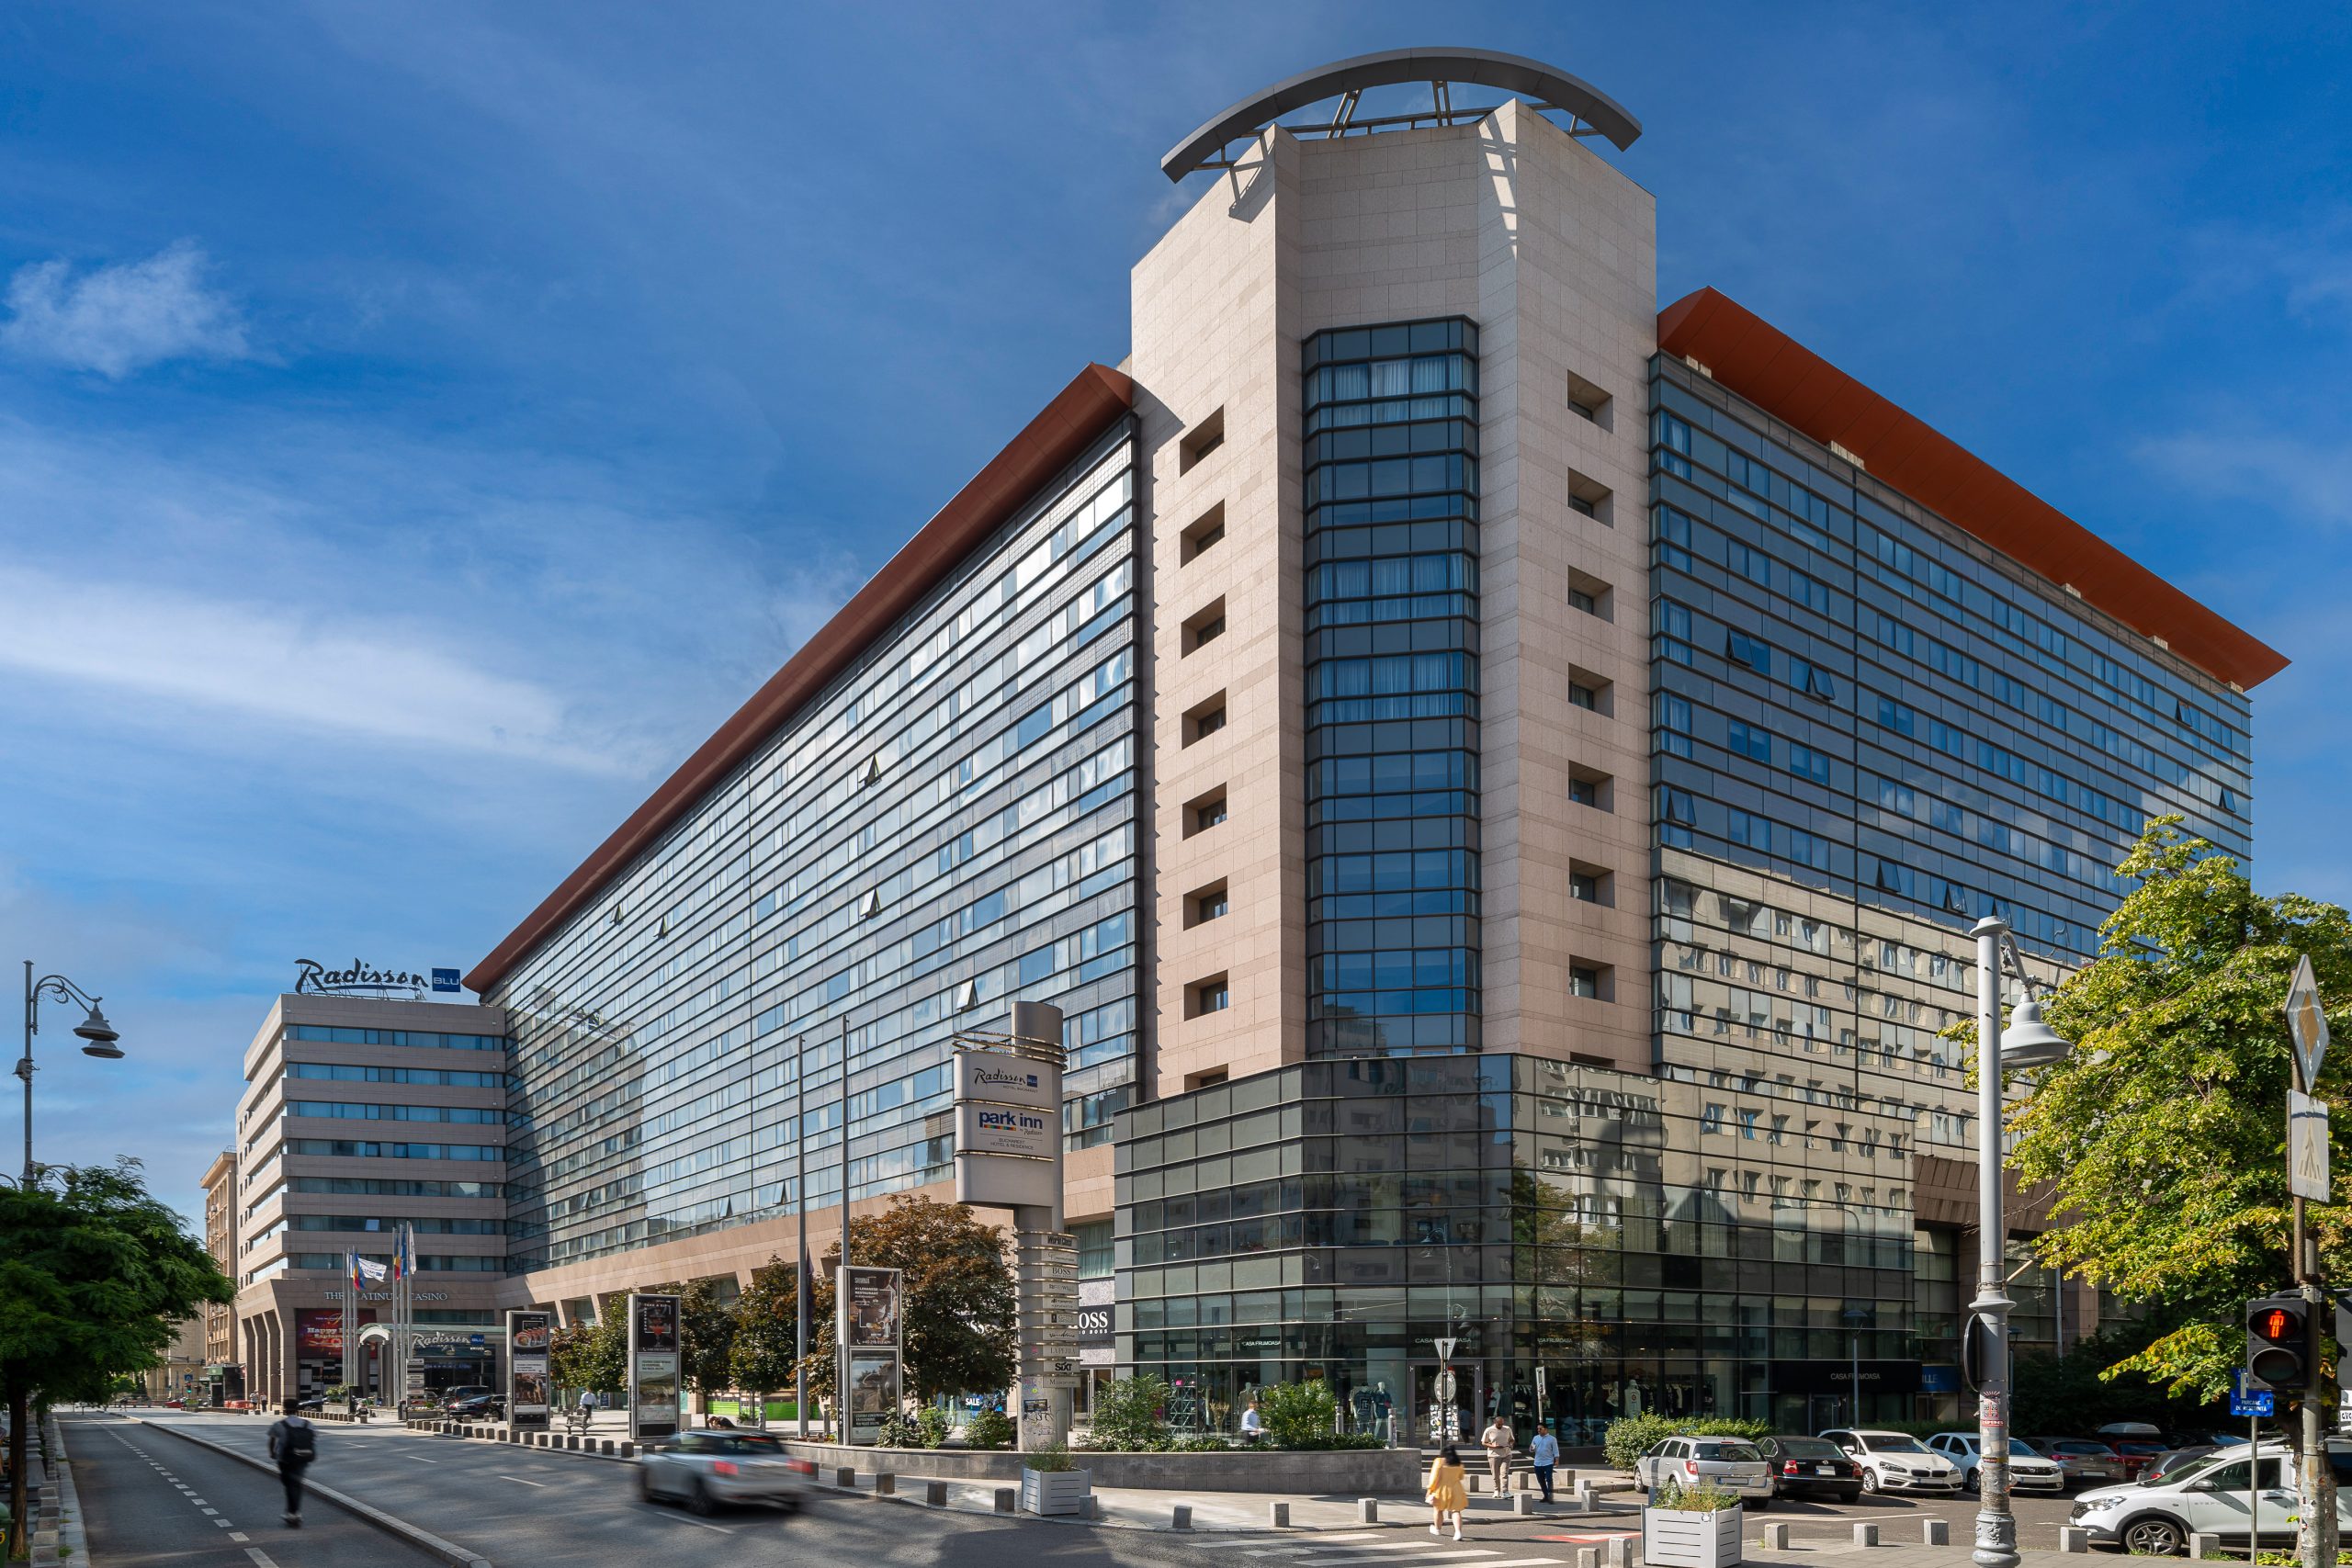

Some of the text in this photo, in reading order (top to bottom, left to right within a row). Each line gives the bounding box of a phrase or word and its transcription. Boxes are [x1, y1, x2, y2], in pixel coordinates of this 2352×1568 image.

[294, 957, 459, 995] Radisson BLU
[974, 1067, 1025, 1085] Radisson
[978, 1111, 1043, 1129] park inn
[1053, 1267, 1070, 1275] BOSS
[1079, 1311, 1108, 1329] OSS
[412, 1331, 470, 1349] Radisson
[965, 1397, 980, 1406] SALE
